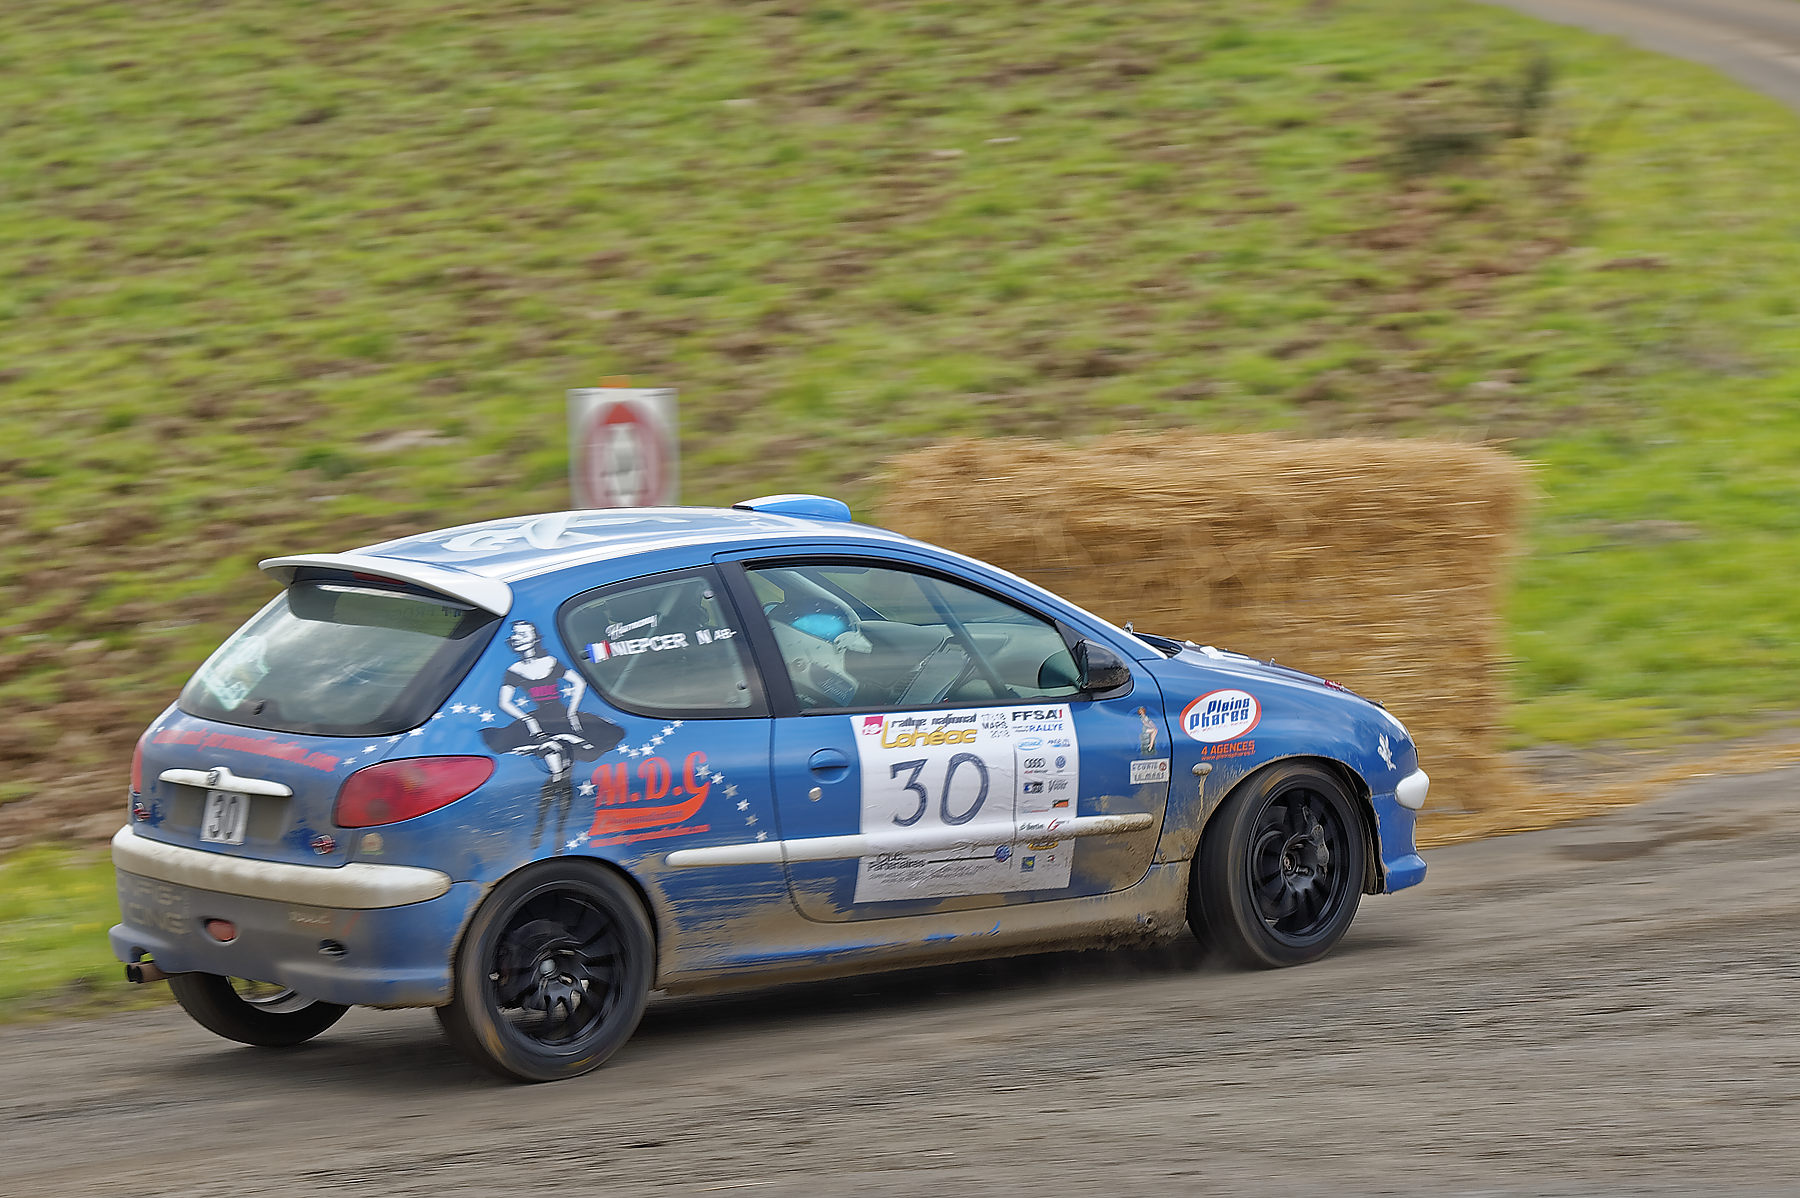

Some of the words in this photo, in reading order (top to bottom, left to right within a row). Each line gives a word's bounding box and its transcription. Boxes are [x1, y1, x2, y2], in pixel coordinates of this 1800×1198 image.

[1201, 746, 1208, 756] 4
[1210, 740, 1256, 754] AGENCES
[889, 752, 989, 827] 30
